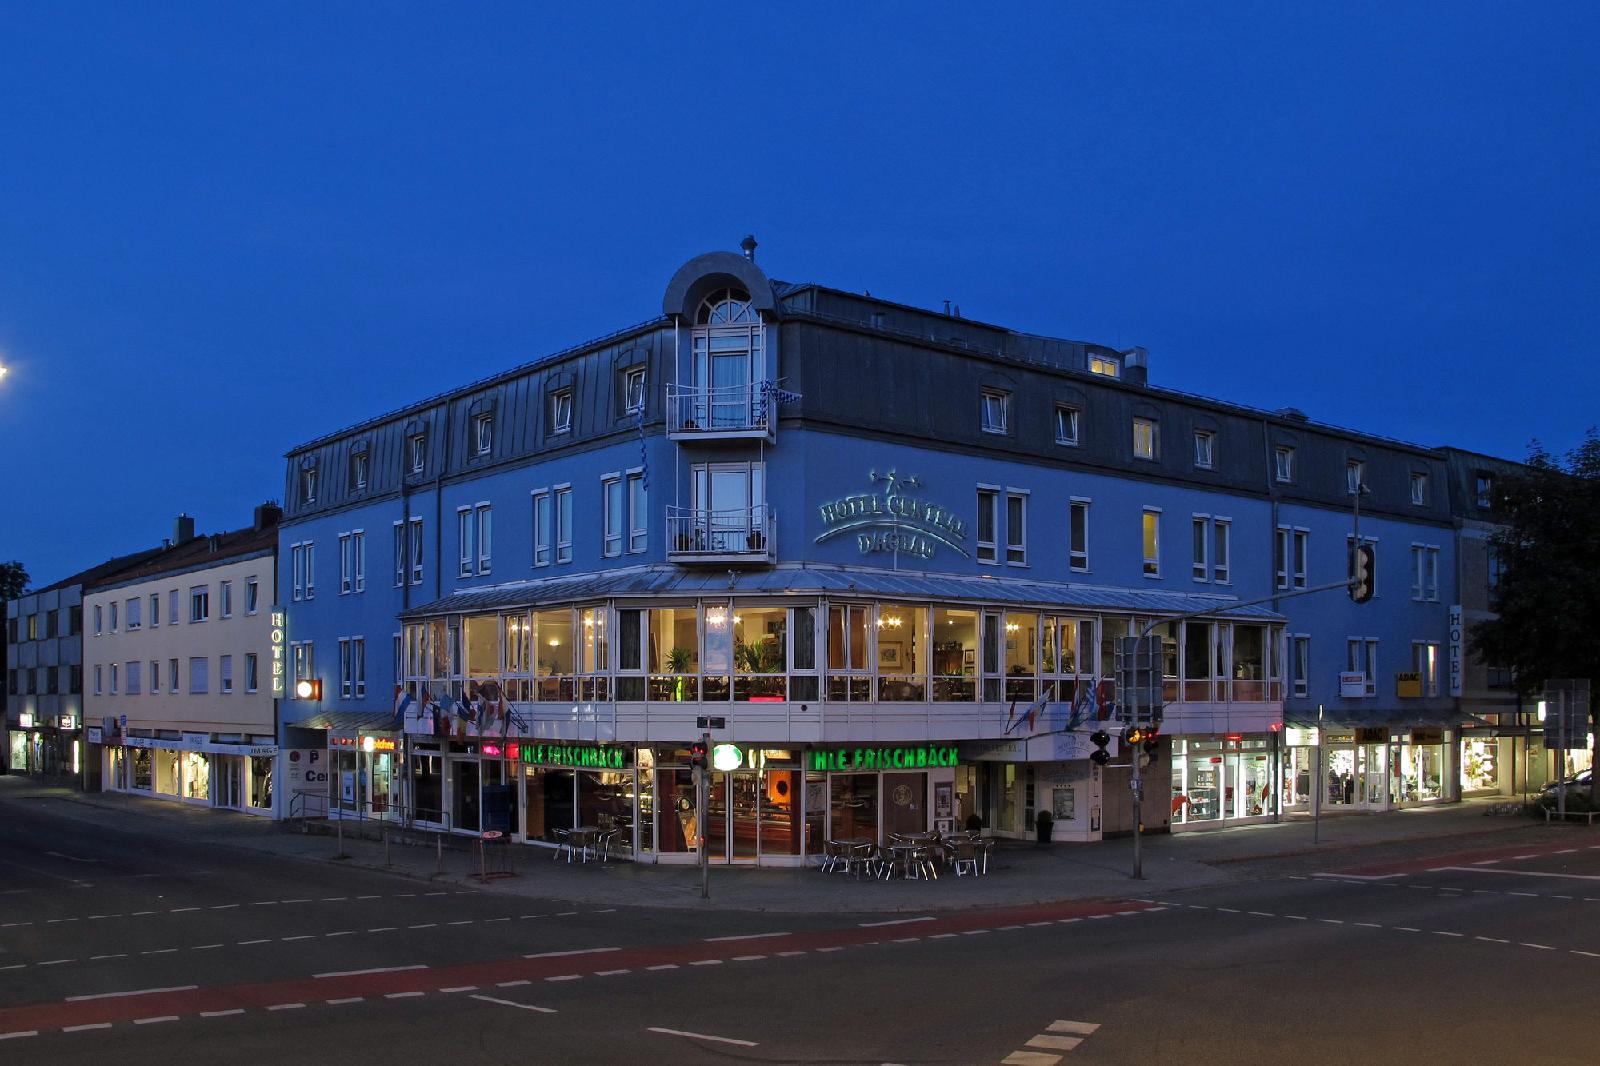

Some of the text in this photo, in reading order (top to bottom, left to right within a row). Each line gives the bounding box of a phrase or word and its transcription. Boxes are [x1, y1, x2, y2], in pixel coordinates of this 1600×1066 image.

[820, 494, 883, 524] HOTEL
[271, 612, 284, 692] HOTEL
[1450, 613, 1461, 689] HOTEL
[1398, 672, 1419, 681] ADAC
[520, 744, 543, 764] IHLE
[548, 744, 624, 769] FRISCHBÄCK
[807, 749, 848, 771] IHLE
[854, 743, 960, 769] FRISCHBÄCK
